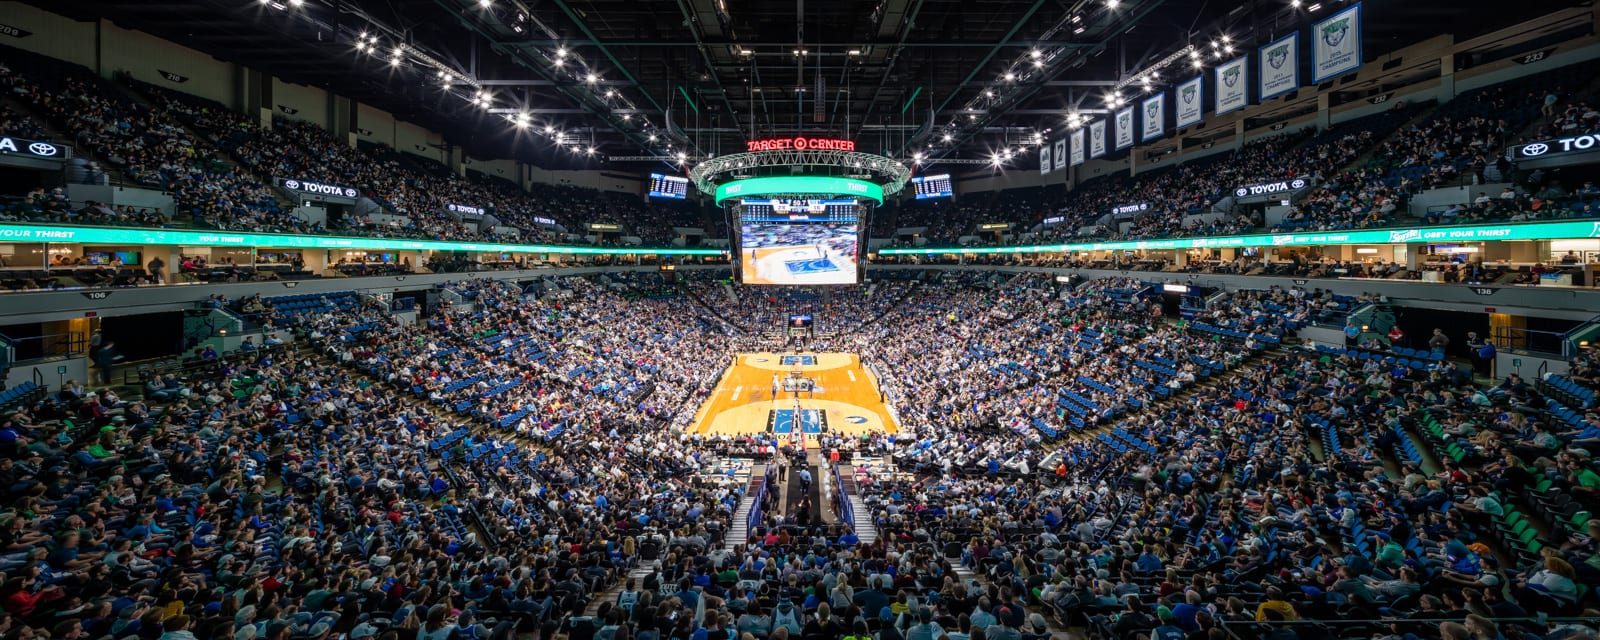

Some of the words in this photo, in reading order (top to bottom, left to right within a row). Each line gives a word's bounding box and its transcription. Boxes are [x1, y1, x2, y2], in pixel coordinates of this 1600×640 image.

[0, 24, 19, 37] 209
[1524, 52, 1544, 64] 233
[747, 139, 792, 151] TARGET
[809, 138, 855, 151] CENTER
[303, 182, 343, 196] TOYOTA
[1250, 182, 1289, 195] TOYOTA
[457, 205, 478, 215] TOYOTA
[1120, 205, 1139, 213] TOYOTA
[35, 230, 75, 238] THIRST
[1424, 231, 1447, 239] OBEY
[1450, 230, 1475, 238] YOUR
[1477, 229, 1511, 237] THIRST
